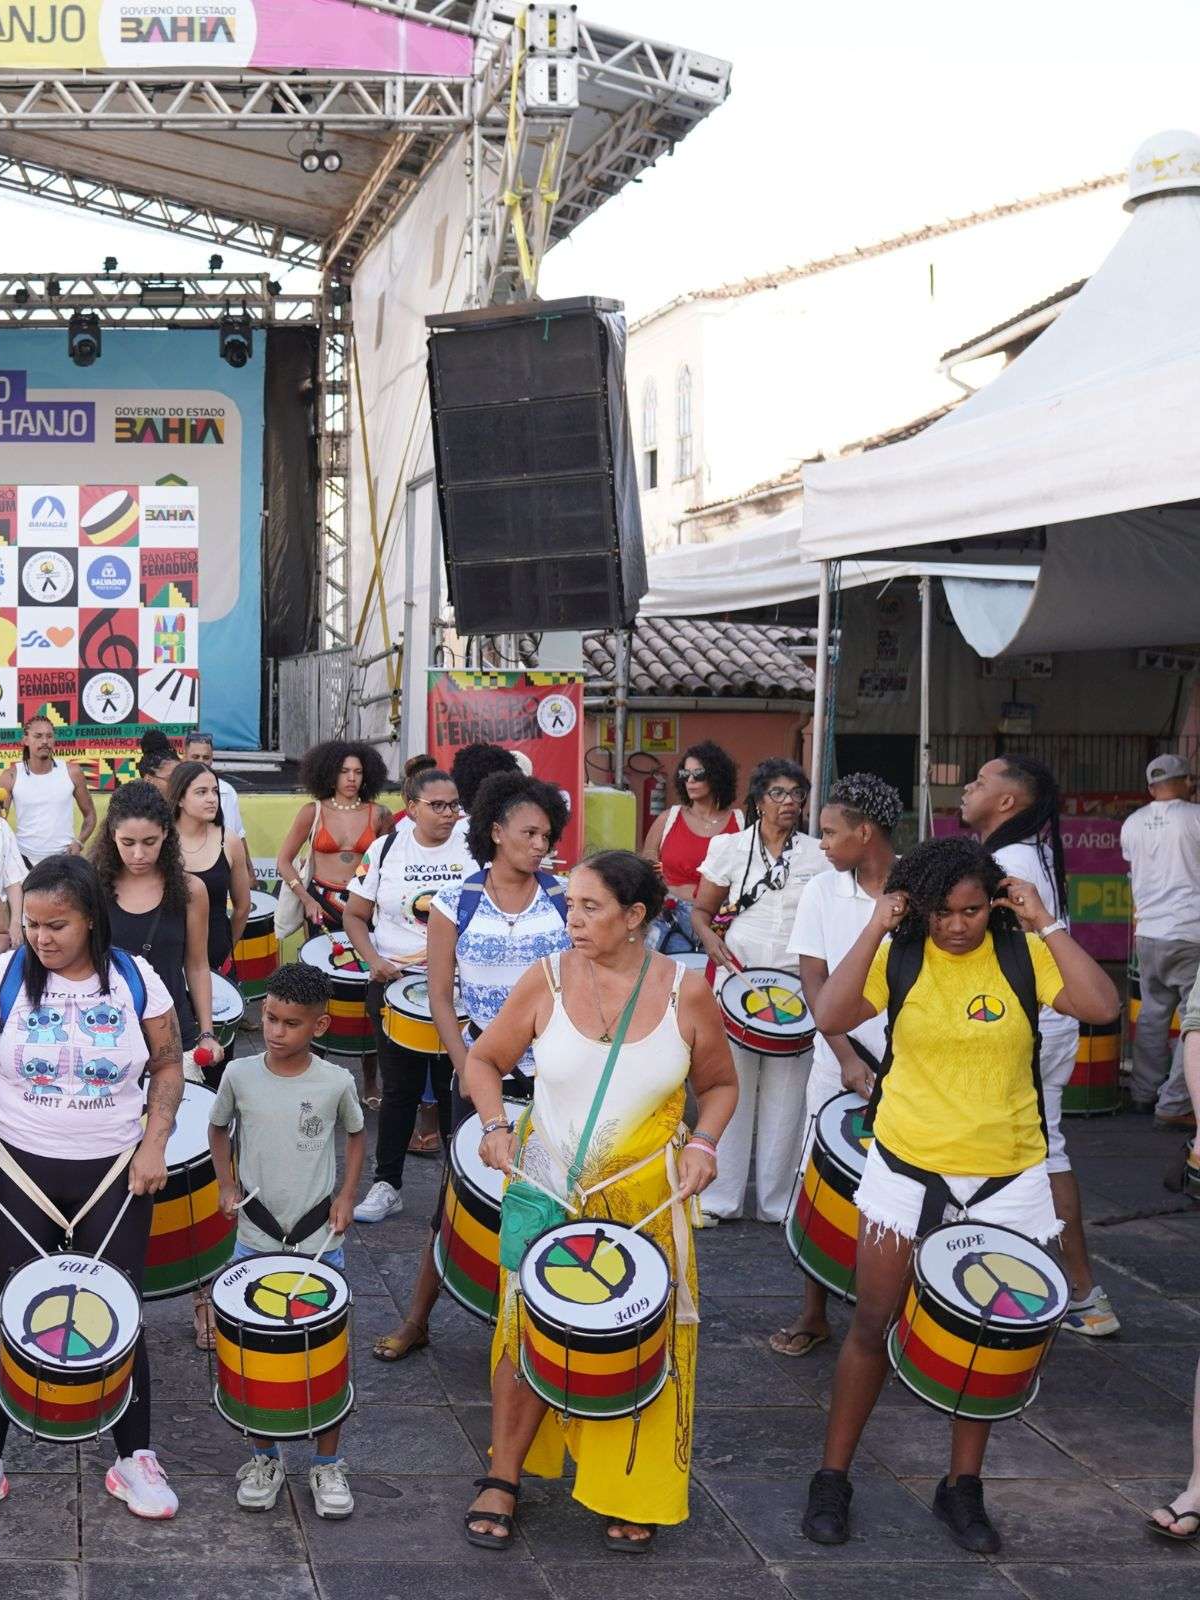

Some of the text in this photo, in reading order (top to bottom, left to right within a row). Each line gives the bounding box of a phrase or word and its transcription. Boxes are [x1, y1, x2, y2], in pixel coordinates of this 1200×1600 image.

[120, 6, 236, 16] GOVERNO DO ESTADO
[115, 407, 225, 417] GOVERNO DO ESTADO
[141, 551, 198, 564] PANAFRO
[142, 562, 198, 577] FEMADUM
[91, 578, 127, 586] SALVADOR
[19, 671, 76, 684] PANAFRO
[19, 682, 77, 697] FEMADUM
[75, 727, 122, 737] FEMADUM
[404, 873, 462, 882] OLODUM
[23, 1091, 116, 1110] SPIRIT ANIMAL
[946, 1233, 986, 1251] GOPE
[223, 1264, 251, 1286] GOPE
[614, 1296, 650, 1326] GOPE
